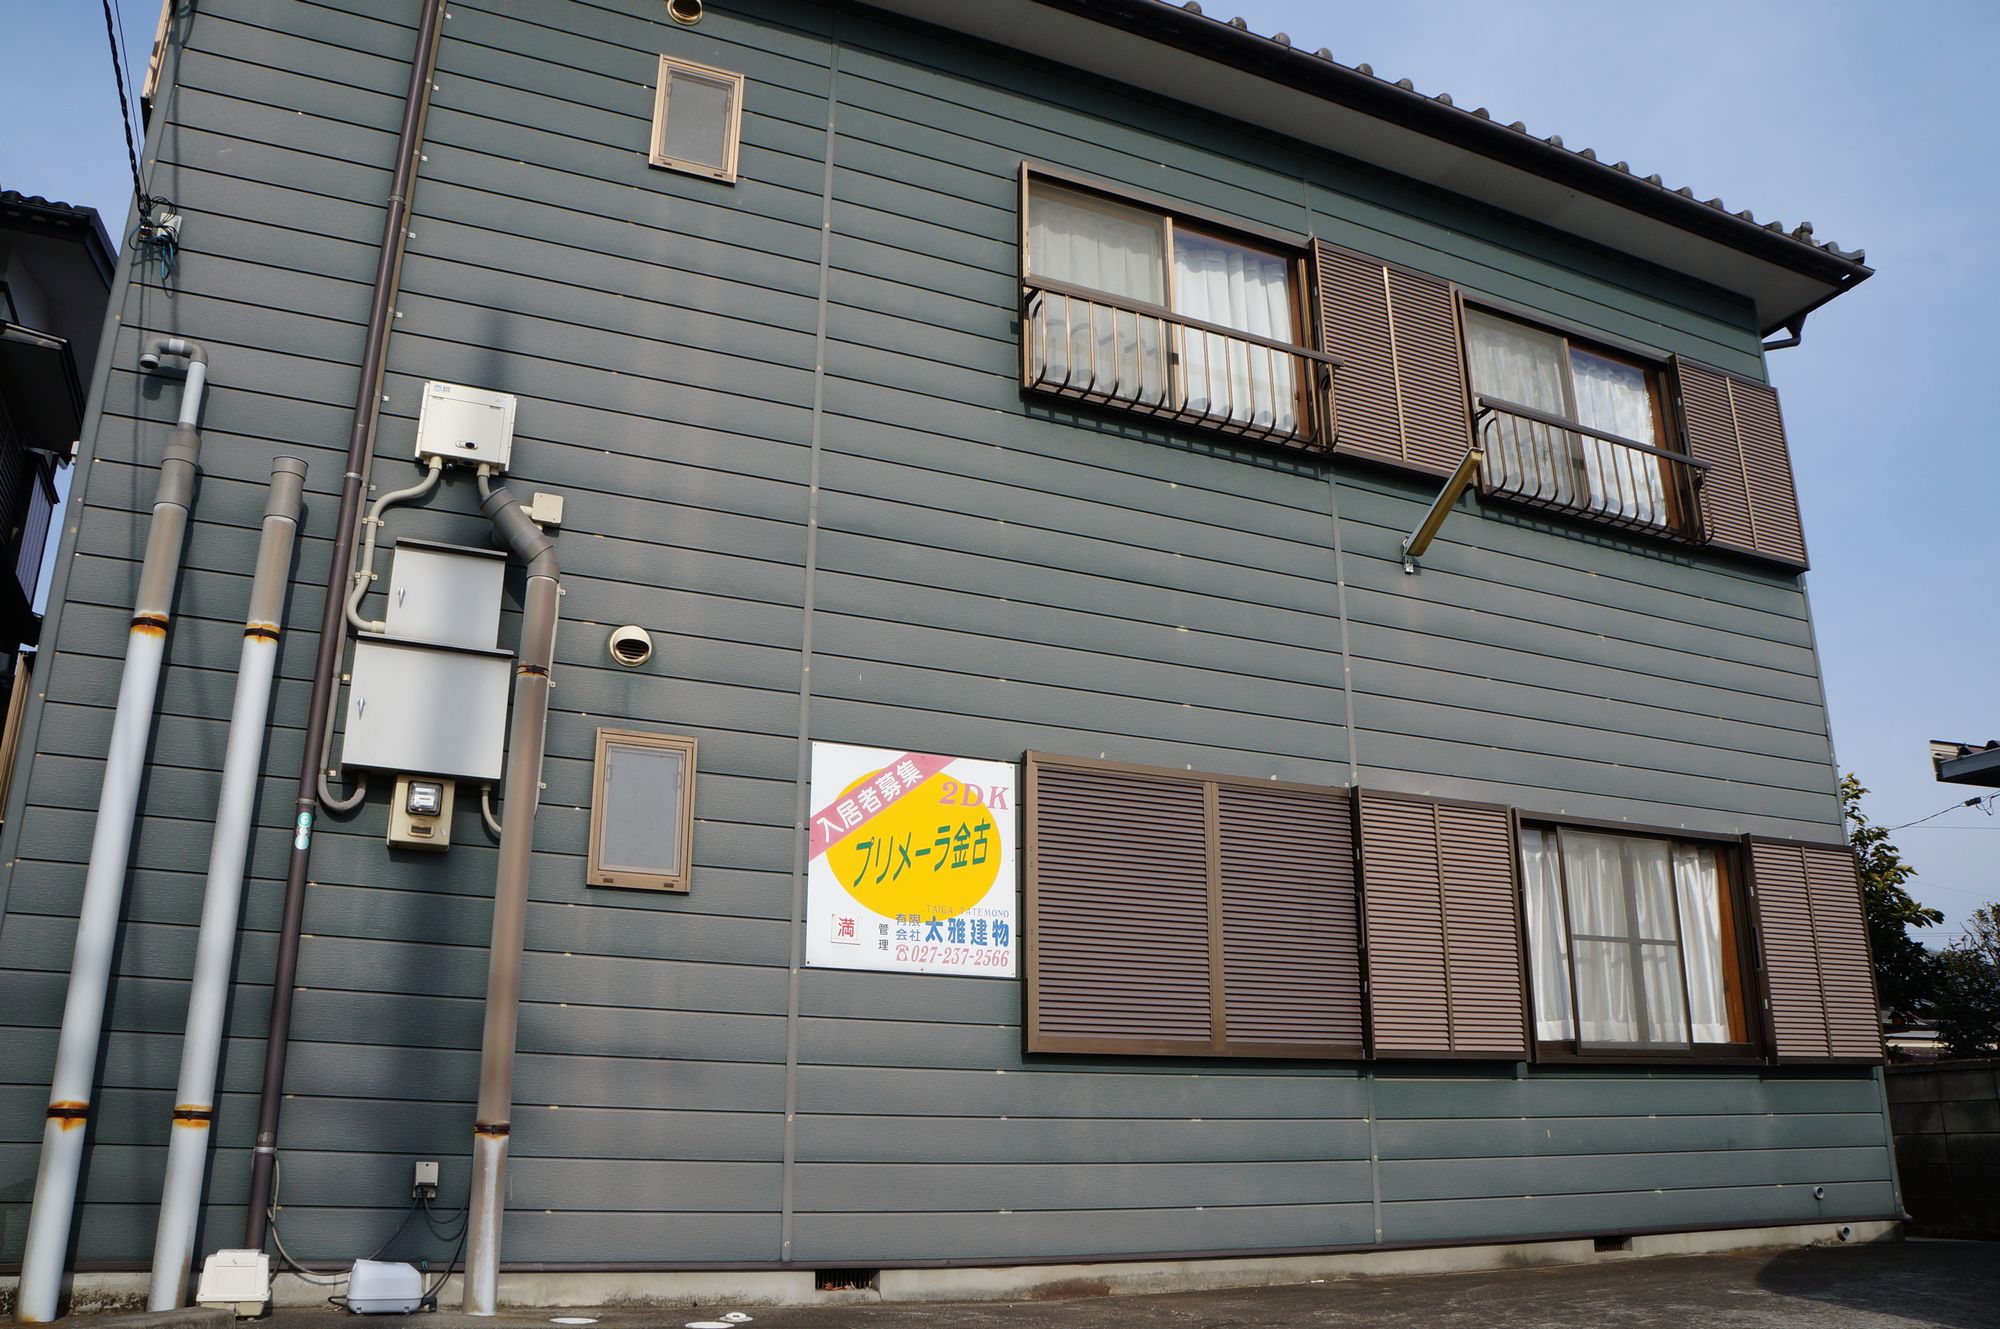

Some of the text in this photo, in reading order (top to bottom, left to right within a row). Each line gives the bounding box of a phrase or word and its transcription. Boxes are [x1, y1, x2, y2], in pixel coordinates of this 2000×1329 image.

[816, 759, 924, 843] 入居者募集
[939, 781, 1009, 811] 2DK
[853, 817, 991, 888] プリメーラ金古
[895, 913, 921, 927] 有限
[926, 904, 1010, 919] TAIGA TATEMONO
[838, 917, 855, 938] 満
[878, 923, 889, 951] 管理
[895, 928, 921, 942] 会社
[925, 915, 1010, 948] 太雅建物
[911, 944, 1010, 968] 027-237-2566
